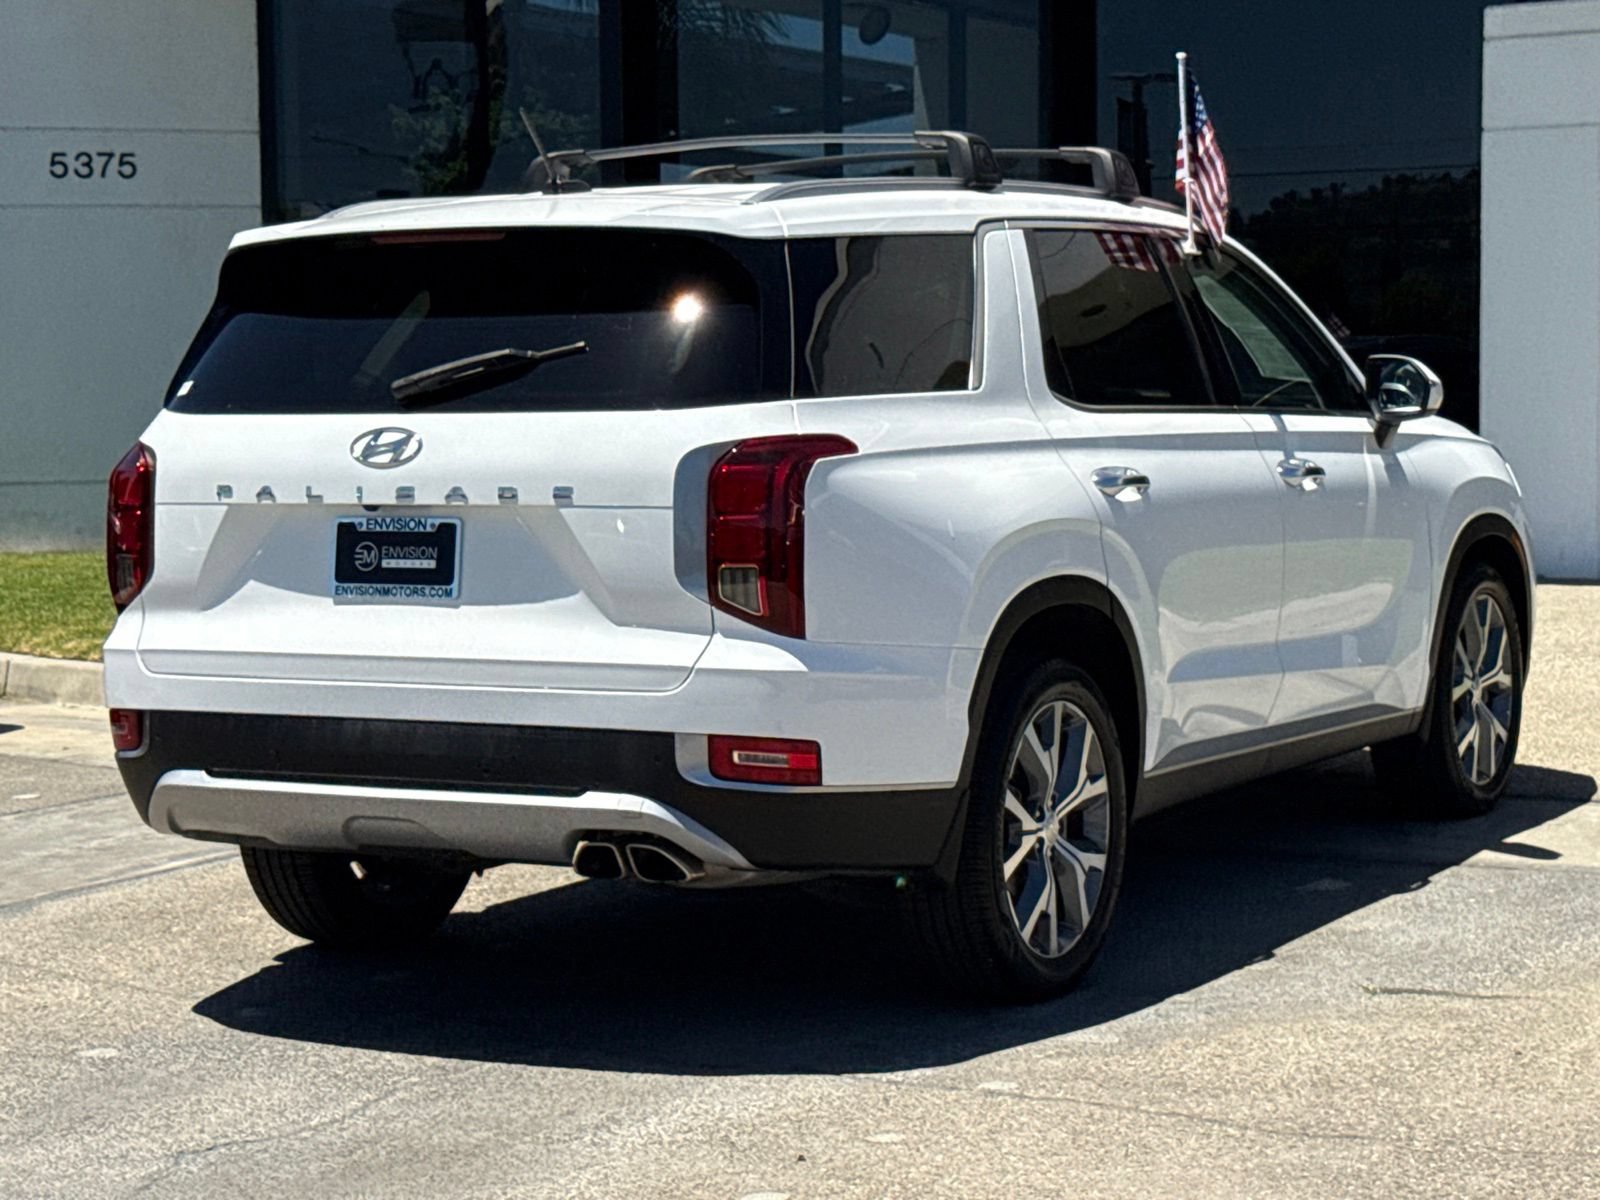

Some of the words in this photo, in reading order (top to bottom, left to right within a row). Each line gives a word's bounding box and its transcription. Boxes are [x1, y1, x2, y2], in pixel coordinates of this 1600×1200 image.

[49, 151, 137, 179] 5375
[366, 518, 427, 530] ENVISION
[381, 546, 438, 559] ENVISION
[335, 586, 453, 597] ENVISIONMOTORS.COM
